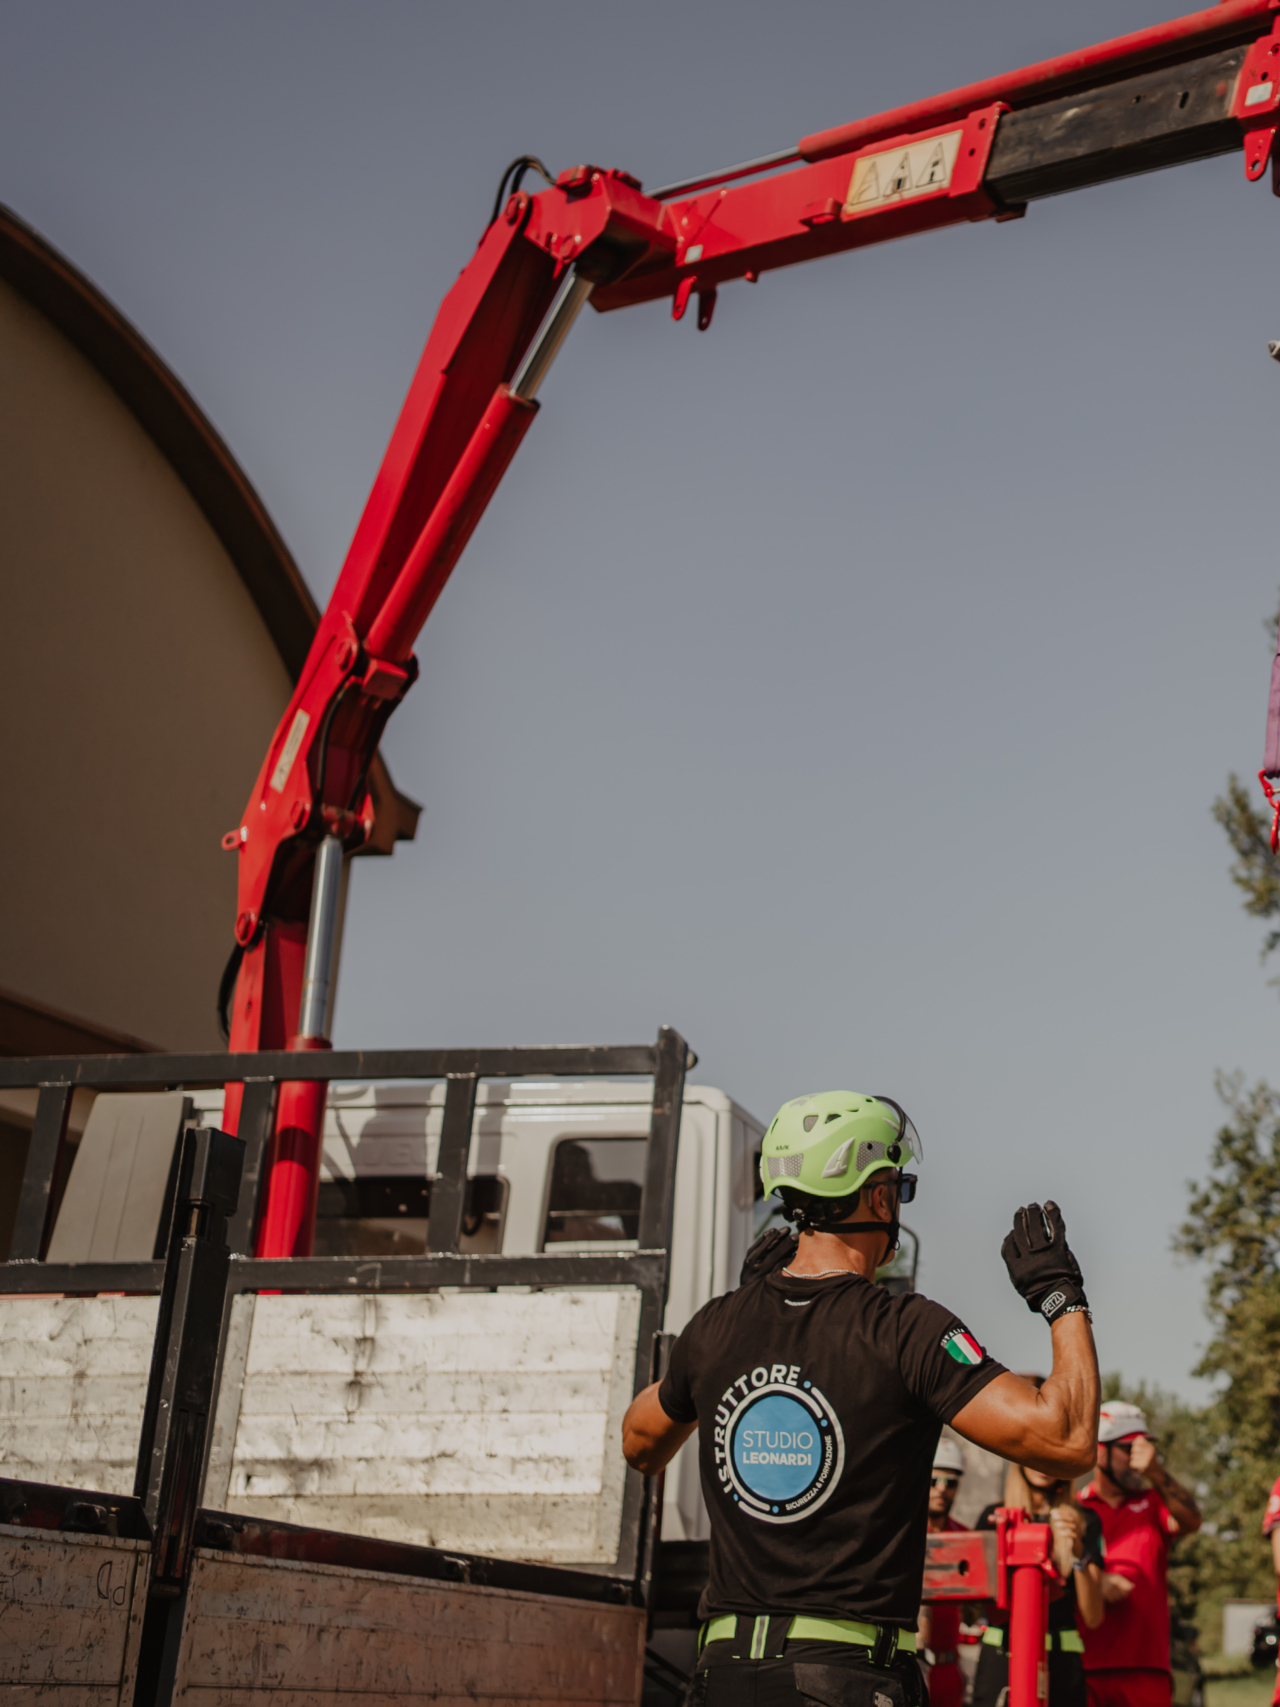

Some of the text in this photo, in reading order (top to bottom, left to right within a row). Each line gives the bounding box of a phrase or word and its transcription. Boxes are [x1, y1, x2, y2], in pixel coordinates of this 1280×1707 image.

[942, 1328, 965, 1344] ITALIA
[714, 1364, 801, 1493] ISTRUTTORE
[743, 1430, 813, 1449] STUDIO
[743, 1451, 812, 1466] LEONARDI
[785, 1435, 833, 1511] SICUREZZA & FORMAZIONE
